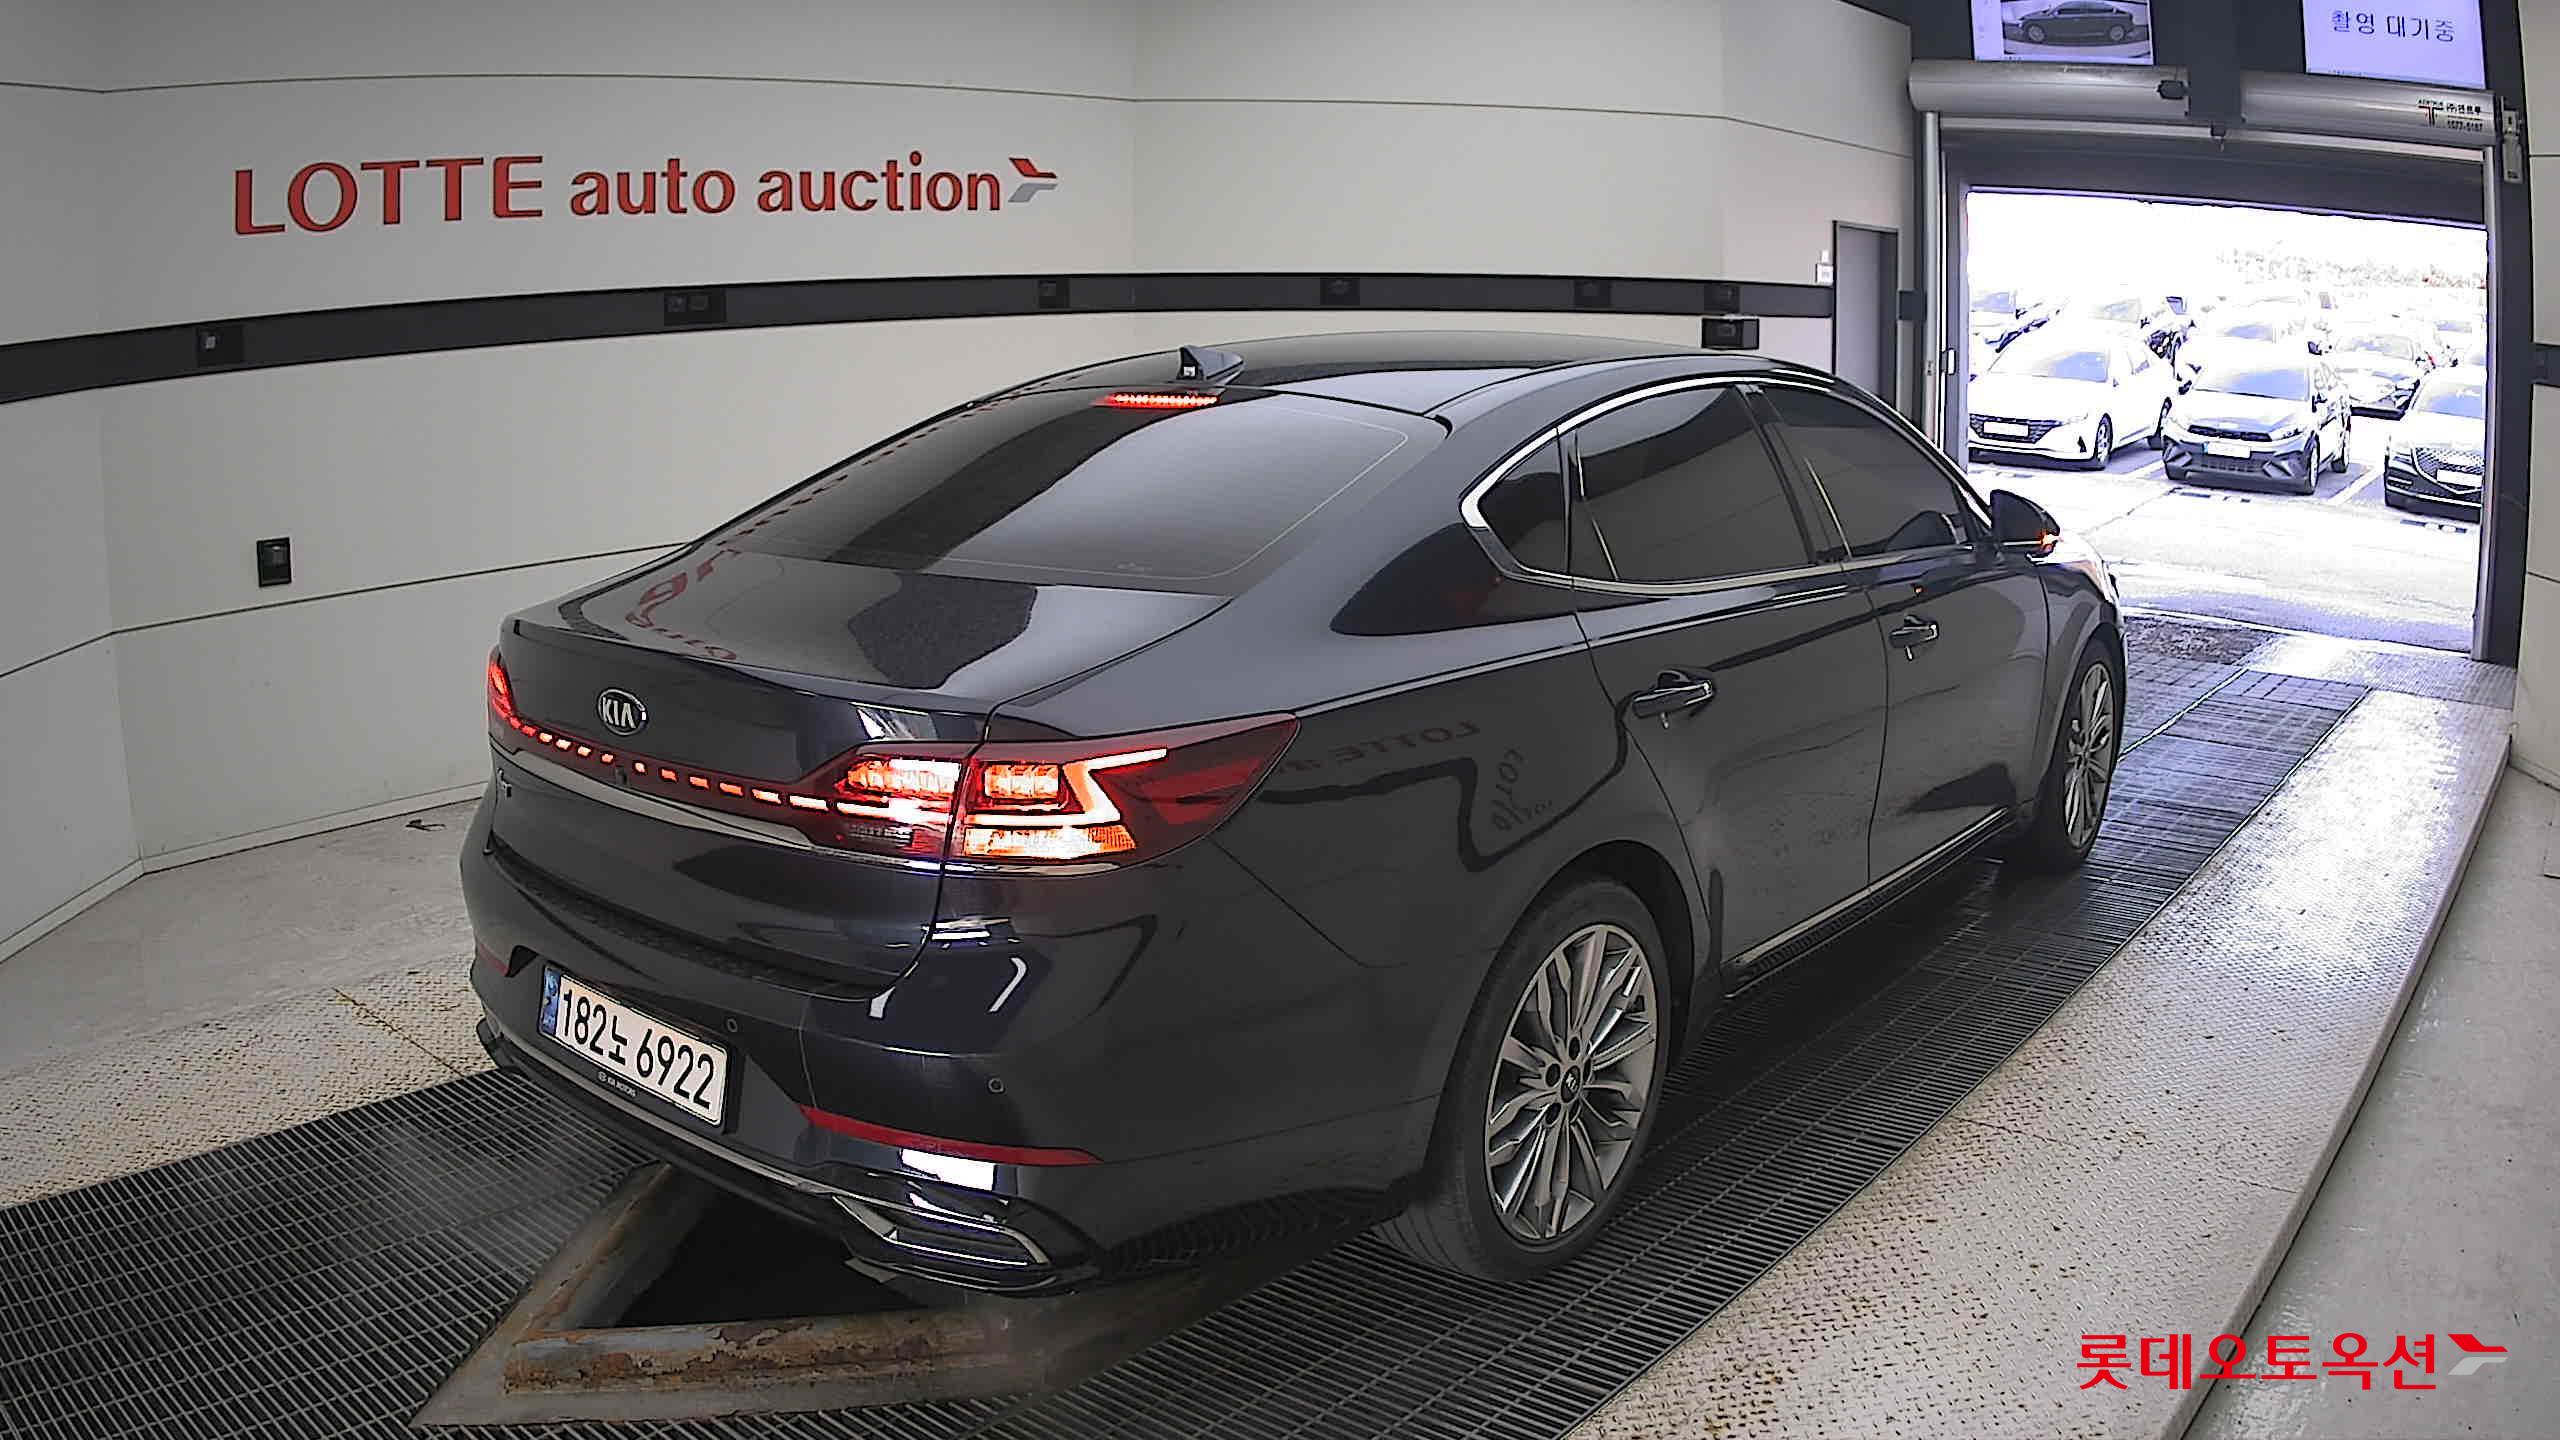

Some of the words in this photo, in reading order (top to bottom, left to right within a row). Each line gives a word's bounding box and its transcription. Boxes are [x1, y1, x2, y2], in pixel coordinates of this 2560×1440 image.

[2386, 15, 2456, 42] 대기중
[234, 156, 543, 235] LOTTE
[570, 158, 736, 216] auto
[757, 151, 1000, 213] auction
[602, 696, 637, 729] KIA
[562, 988, 629, 1066] 182노
[636, 1028, 715, 1110] 6922
